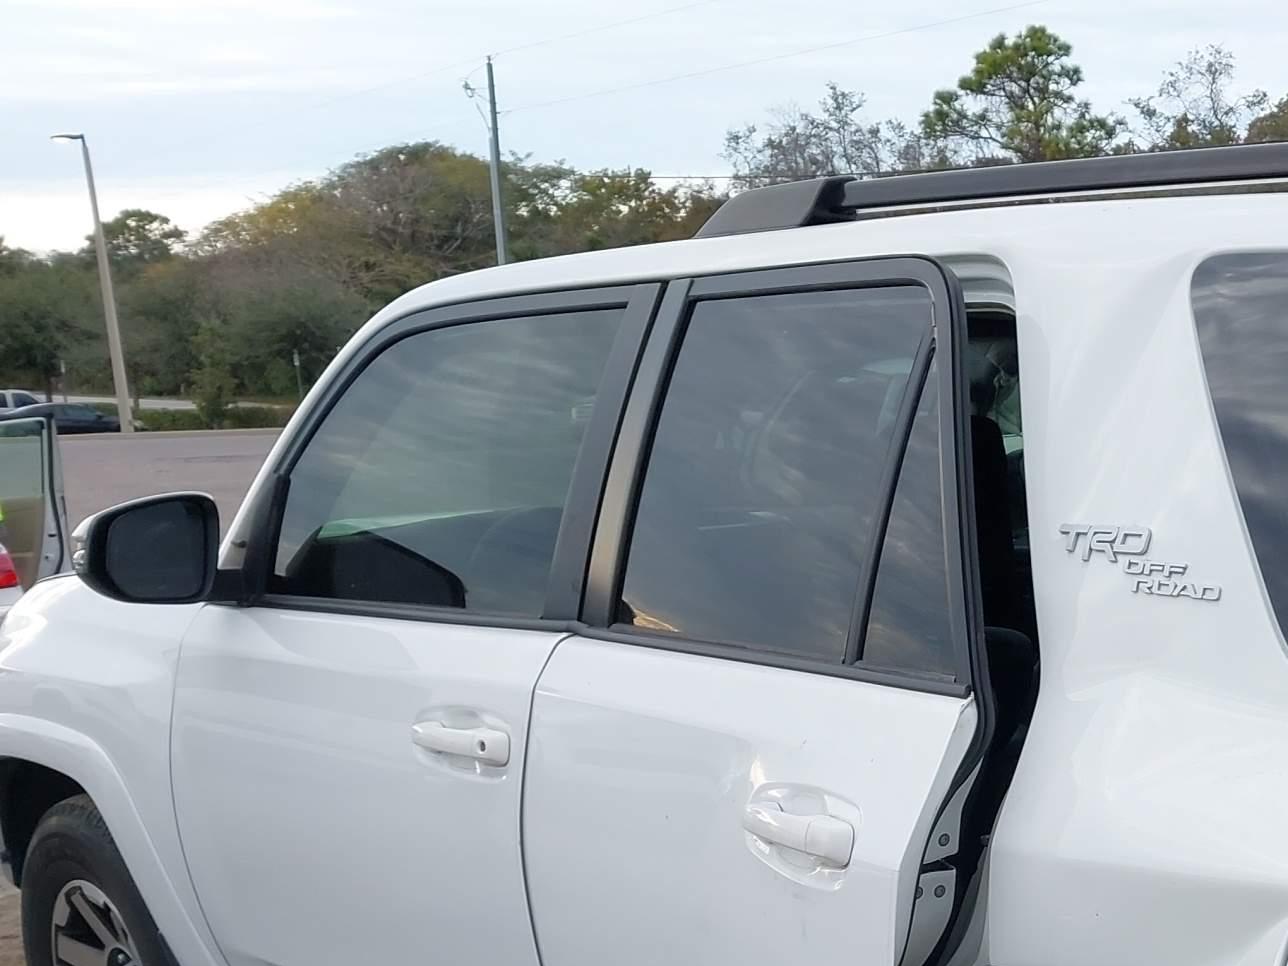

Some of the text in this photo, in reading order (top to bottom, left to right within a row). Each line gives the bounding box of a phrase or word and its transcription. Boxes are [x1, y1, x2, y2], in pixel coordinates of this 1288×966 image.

[1058, 523, 1152, 562] TRD
[1124, 559, 1188, 578] OFF
[1131, 579, 1222, 601] ROAD
